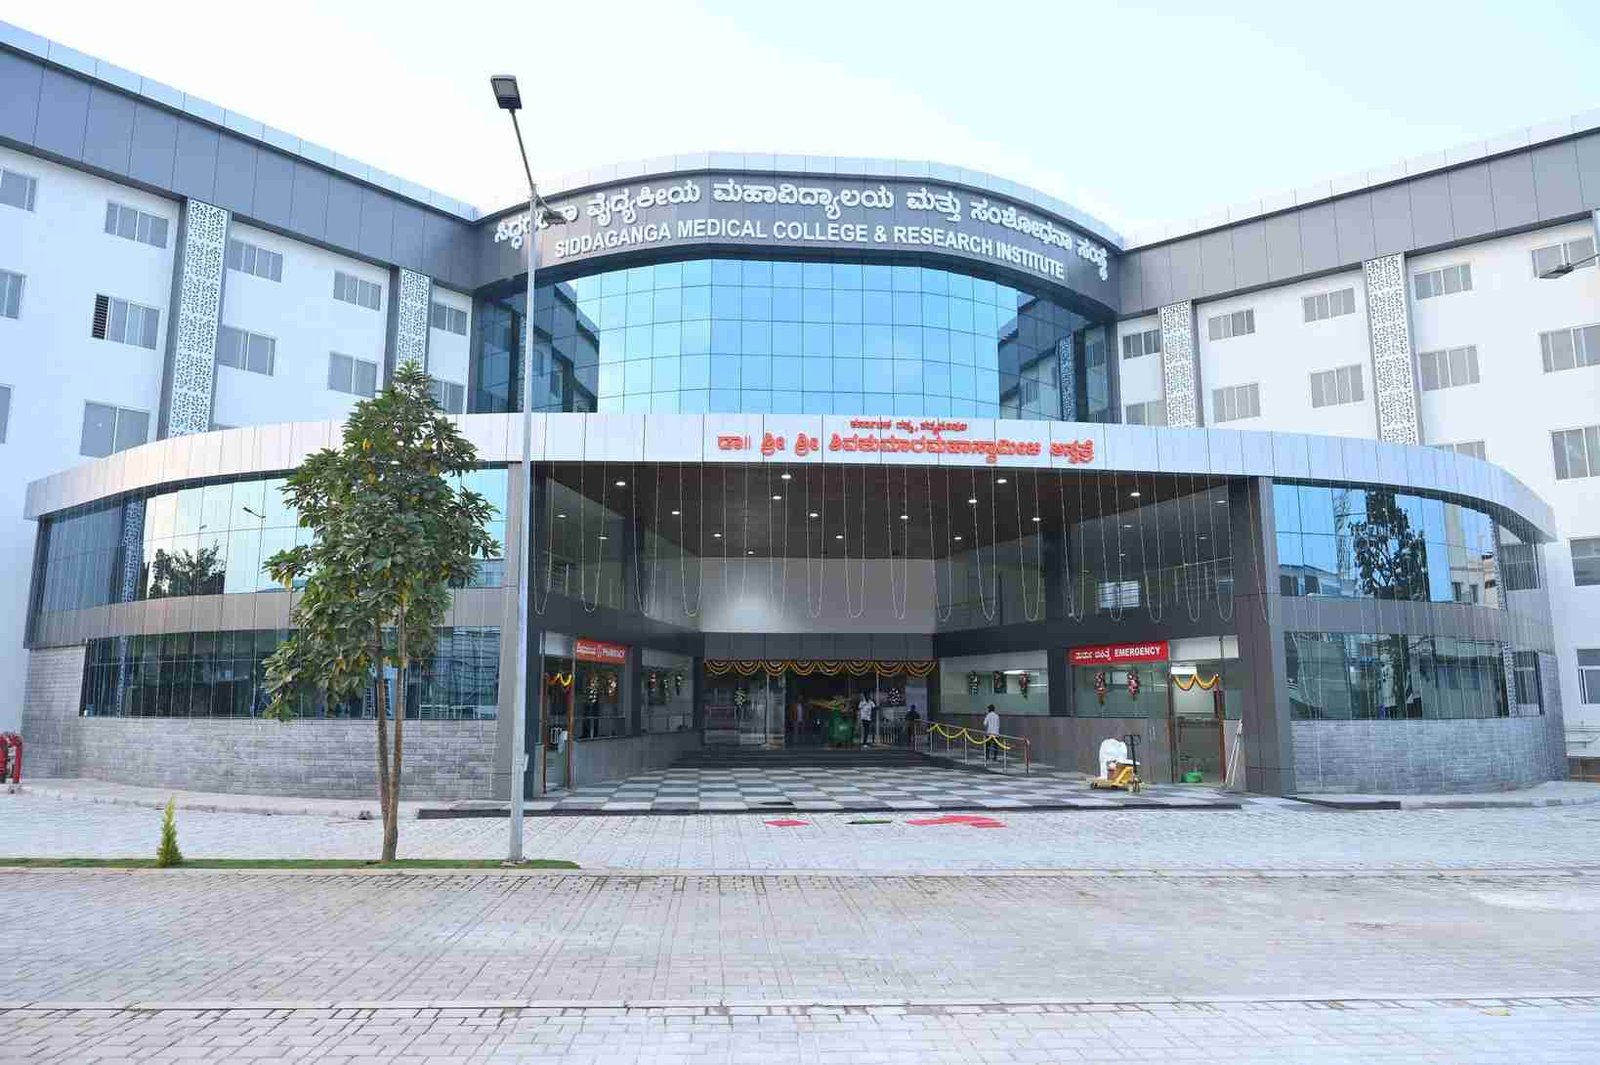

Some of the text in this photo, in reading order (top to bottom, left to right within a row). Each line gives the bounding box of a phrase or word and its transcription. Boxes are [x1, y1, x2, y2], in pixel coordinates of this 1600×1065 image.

[587, 180, 700, 225] ವೈದ್ಯಕೀಯ
[713, 178, 895, 220] ಮಹಾವಿದ್ಯಾಲಯ
[906, 187, 962, 222] ಮತ್ತು
[969, 199, 1072, 250] ಸಂಶೋಧನಾ
[555, 218, 1065, 280] SIDDAGANGA MEDICAL COLLEGE & RESEARCH INSTITUTE
[761, 432, 785, 456] ಶ್ರೀ
[795, 432, 819, 456] ಶ್ರೀ
[1114, 646, 1161, 657] EMERGENCY
